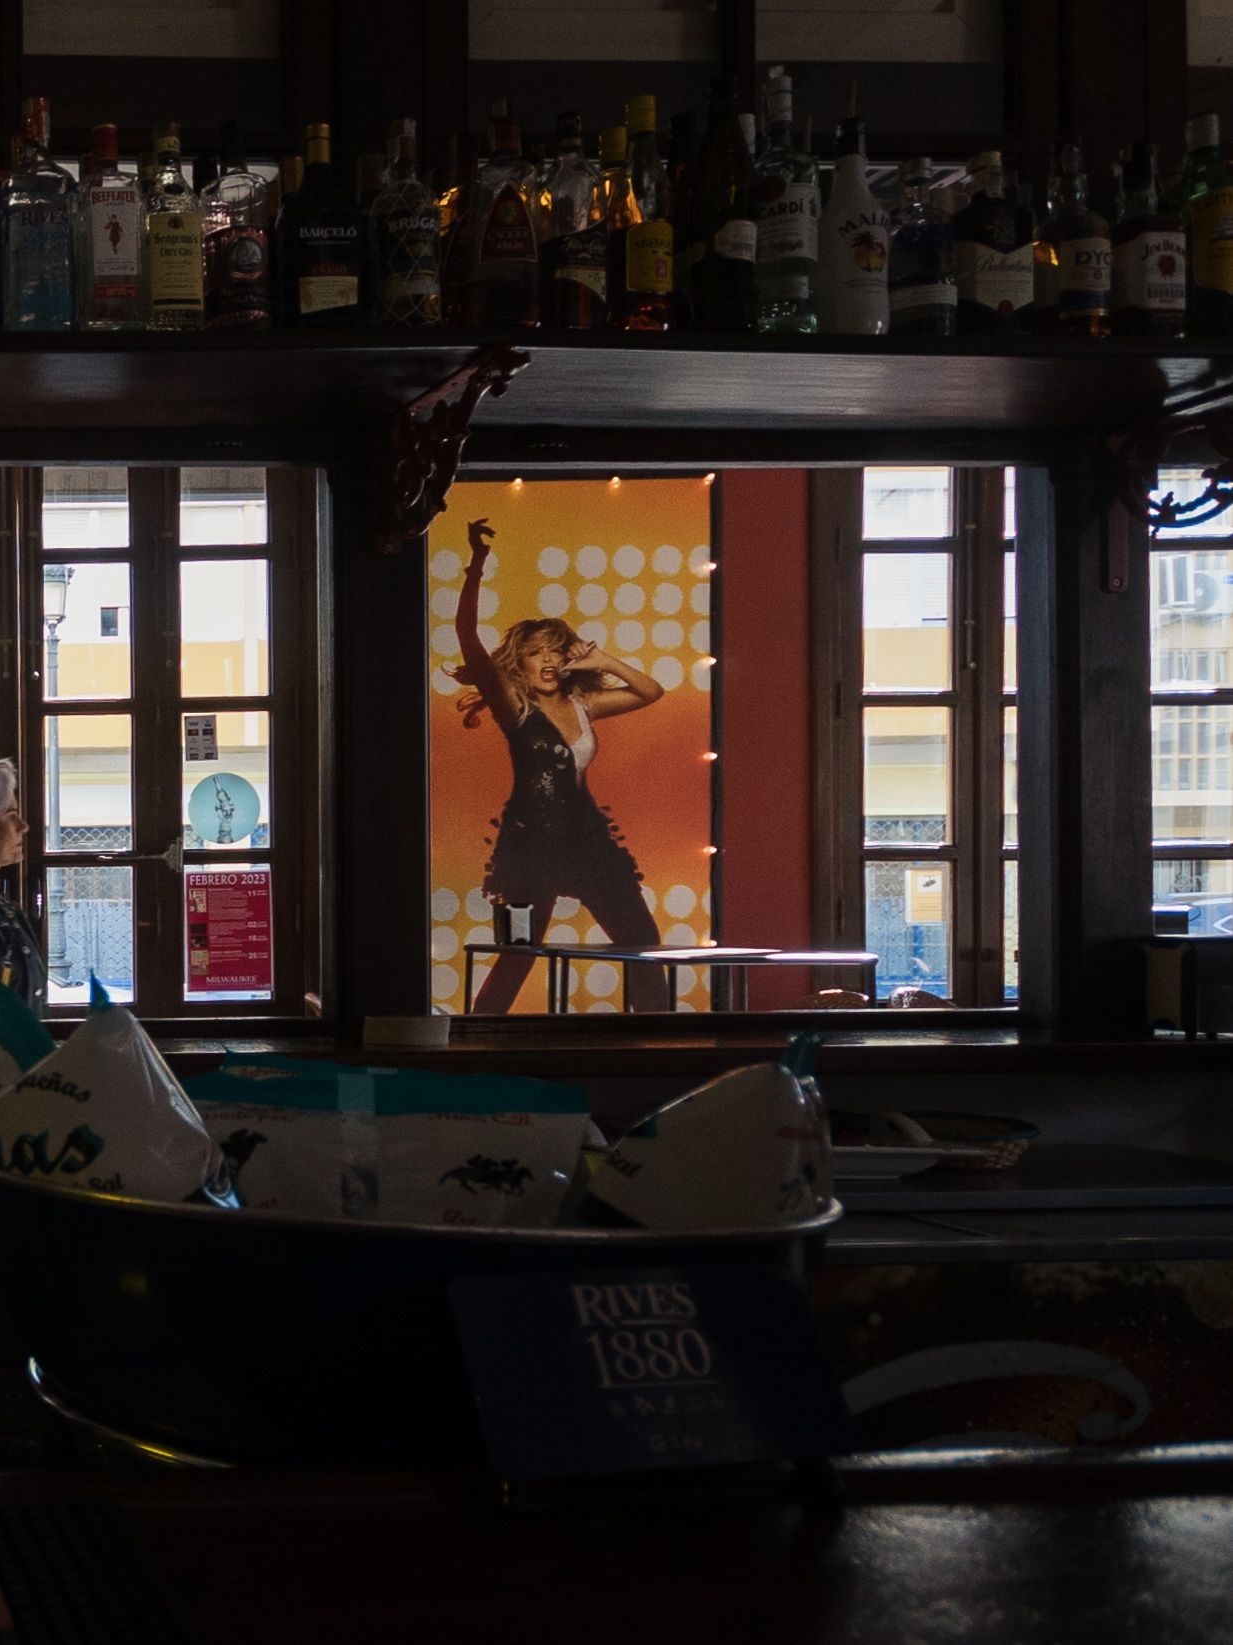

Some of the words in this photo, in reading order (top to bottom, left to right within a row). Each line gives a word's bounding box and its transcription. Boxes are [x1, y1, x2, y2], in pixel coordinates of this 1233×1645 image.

[91, 190, 136, 204] BEEFEATER
[299, 224, 358, 239] BARCELÓ
[189, 874, 238, 886] FEBRERO
[241, 873, 266, 885] 2023
[572, 1281, 699, 1327] RIVES
[586, 1327, 713, 1389] 1880
